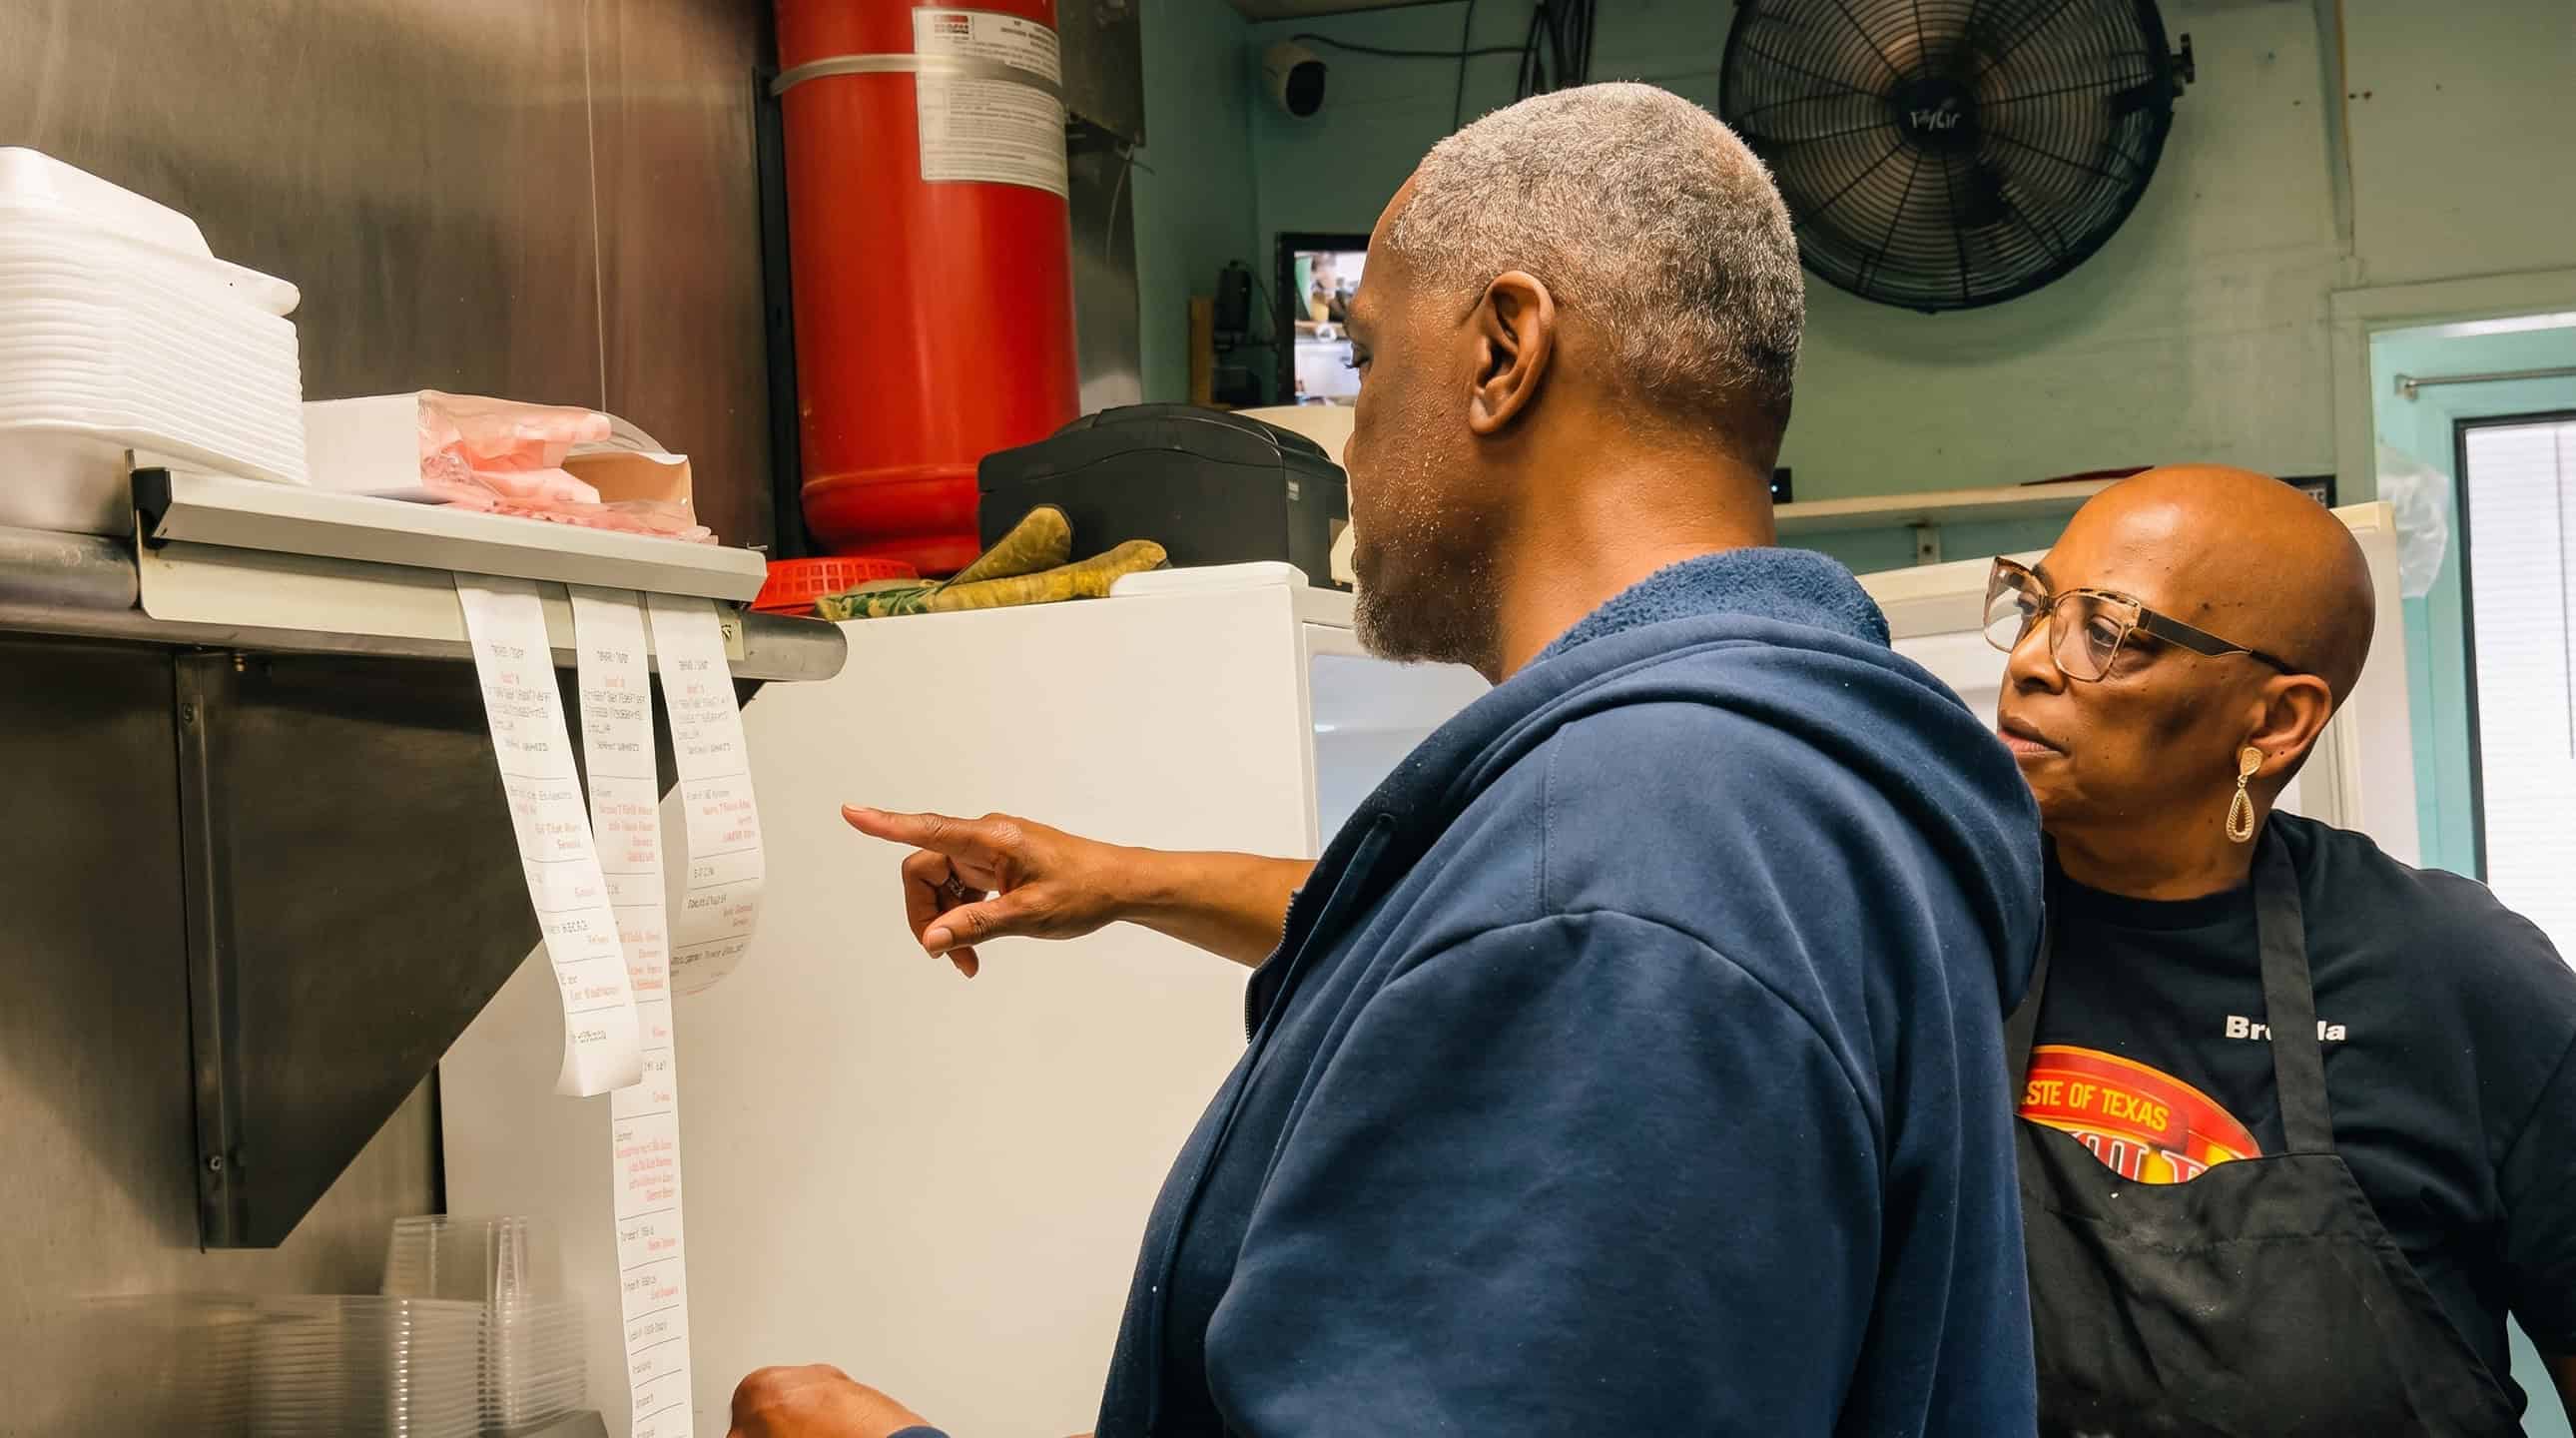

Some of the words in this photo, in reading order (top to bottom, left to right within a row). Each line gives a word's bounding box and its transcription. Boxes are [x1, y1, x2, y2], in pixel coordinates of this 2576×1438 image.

[2023, 1079, 2065, 1106] STE
[2068, 1081, 2097, 1109] OF
[2101, 1087, 2171, 1132] TEXAS
